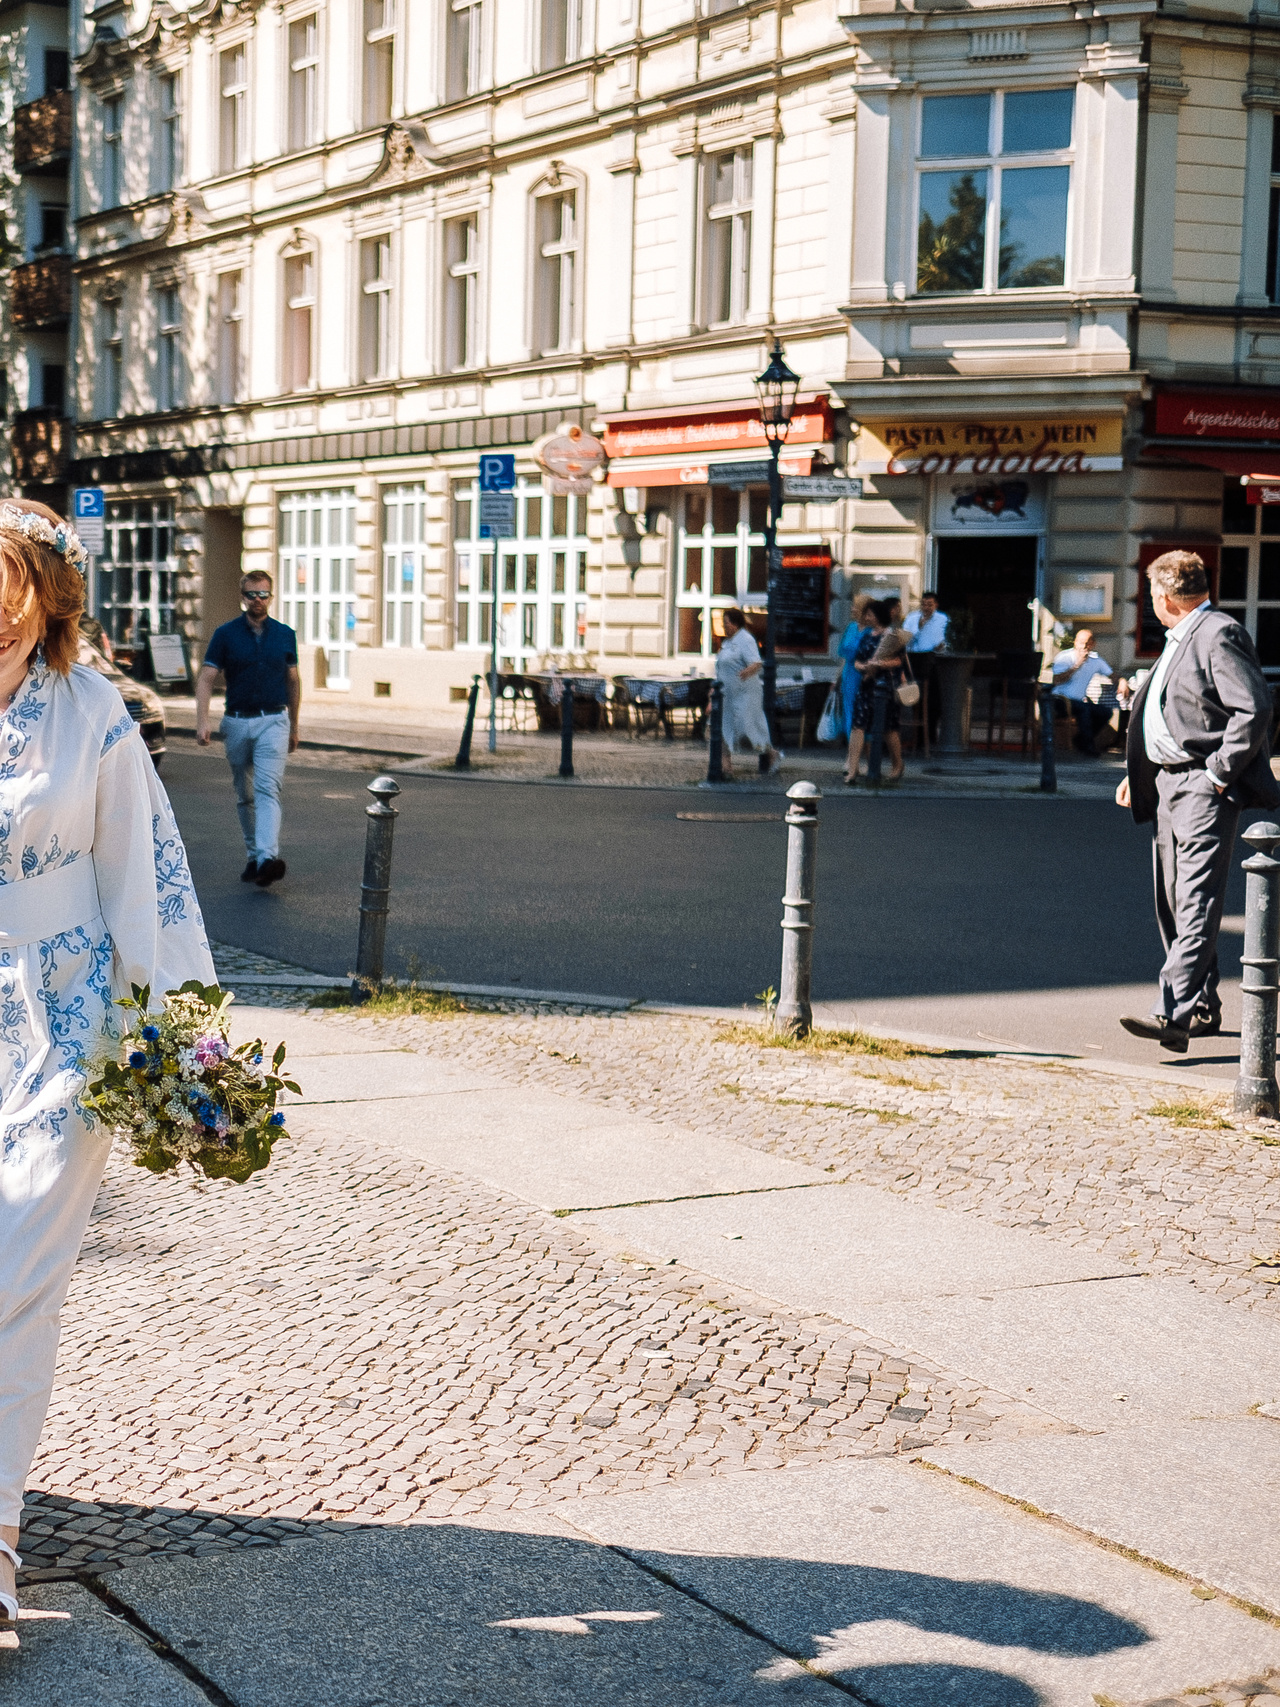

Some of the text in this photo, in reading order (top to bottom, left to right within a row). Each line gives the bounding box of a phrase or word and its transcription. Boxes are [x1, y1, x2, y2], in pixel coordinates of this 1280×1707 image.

[885, 423, 1098, 446] PASTA PIZZA WEIN
[887, 428, 1094, 476] Cordoba
[483, 459, 504, 487] P
[80, 492, 96, 515] P
